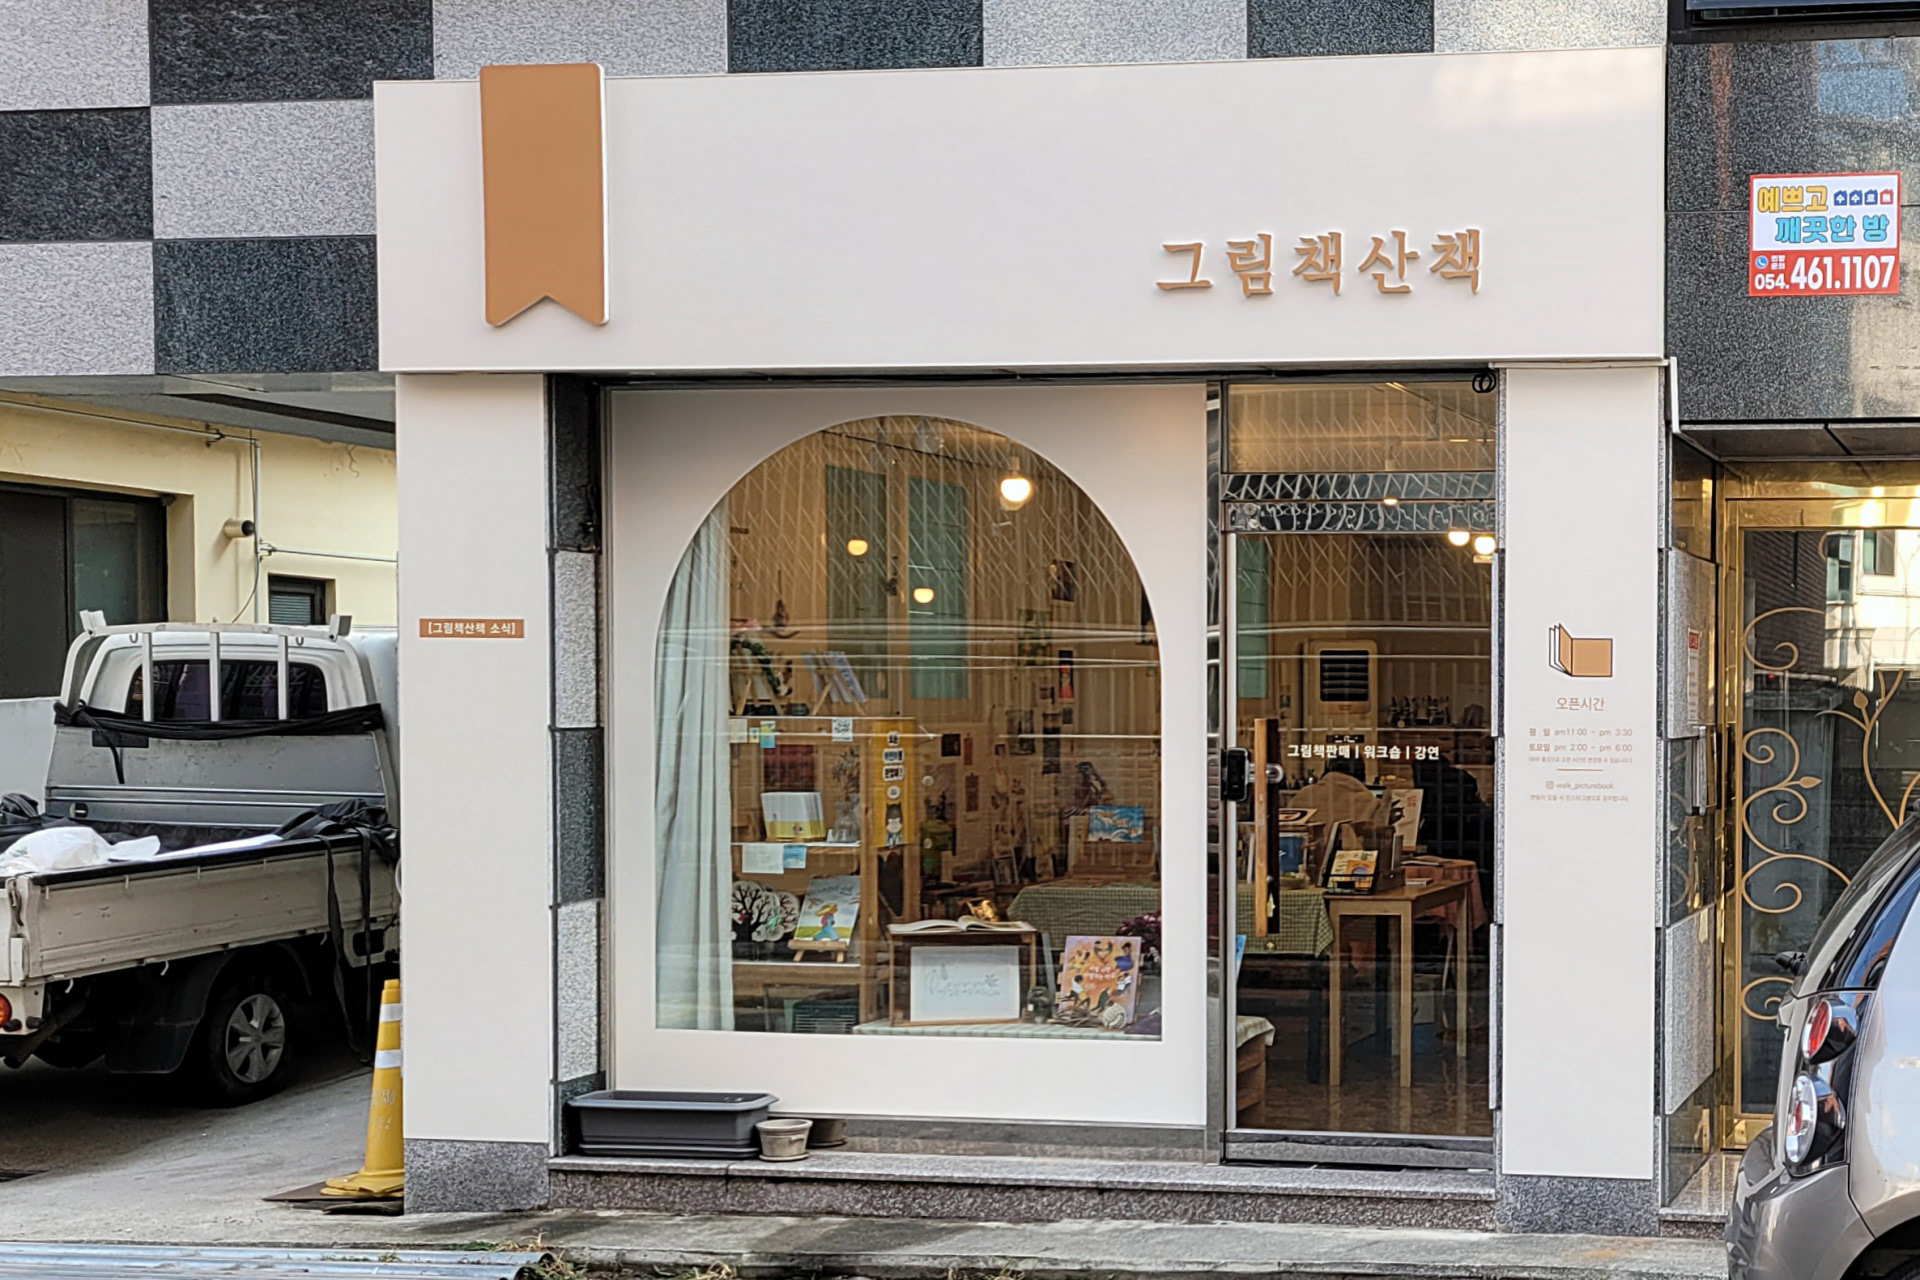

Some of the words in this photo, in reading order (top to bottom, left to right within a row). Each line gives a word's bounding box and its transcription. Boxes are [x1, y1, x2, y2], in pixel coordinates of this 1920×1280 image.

[1757, 186, 1829, 213] 예쁘고
[1775, 215, 1857, 243] 깨끗한
[1863, 215, 1890, 242] 방
[1155, 229, 1481, 297] 그림책산책
[1556, 697, 1605, 711] 오픈시간
[1599, 729, 1612, 737] pm
[1287, 744, 1350, 759] 그림책판매
[1364, 745, 1402, 760] 워크숍
[1414, 746, 1440, 760] 강연
[1529, 743, 1550, 752] 토요일
[1570, 743, 1588, 752] 2:00
[1615, 744, 1633, 752] 6:00
